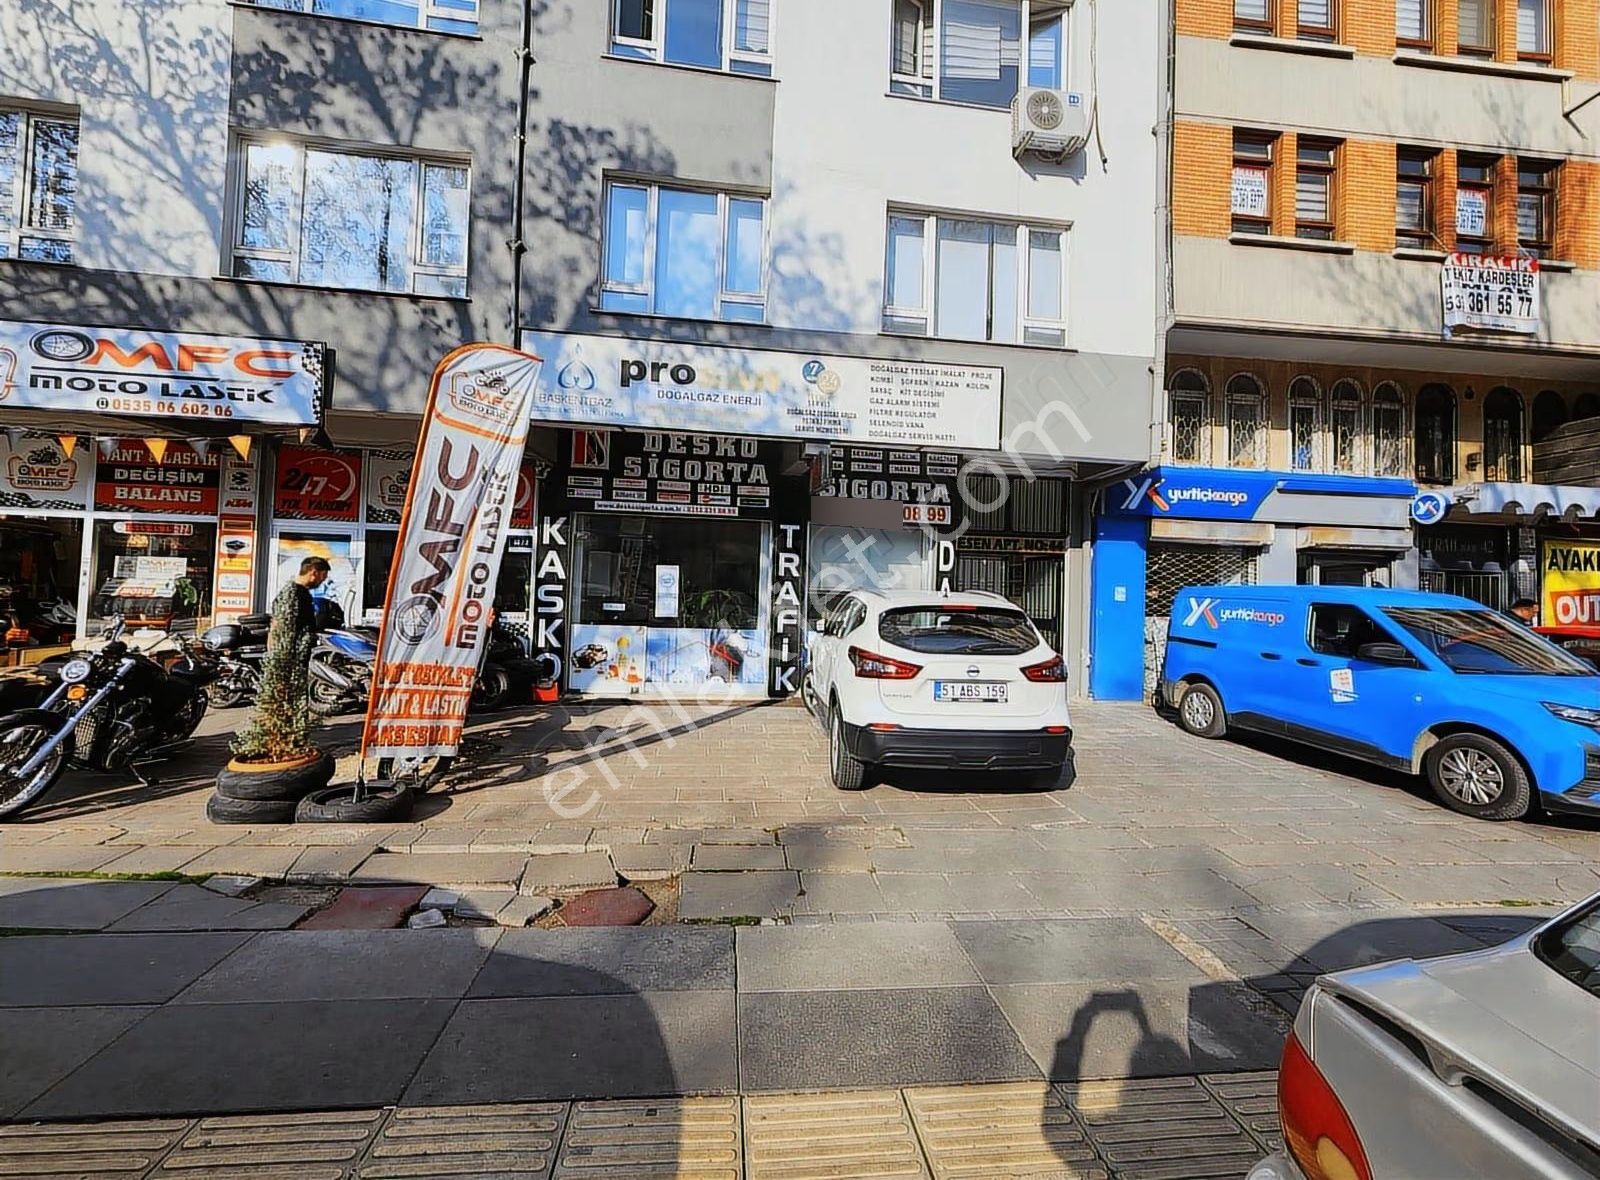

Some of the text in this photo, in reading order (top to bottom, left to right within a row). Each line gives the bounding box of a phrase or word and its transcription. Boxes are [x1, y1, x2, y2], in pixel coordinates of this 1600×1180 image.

[1468, 291, 1490, 312] 361
[1498, 294, 1512, 314] 55
[1518, 296, 1532, 317] 77
[870, 364, 908, 374] DOĞALGAZ
[971, 371, 993, 380] PROJE
[29, 374, 282, 404] MOTO LASTİK
[935, 380, 960, 388] KAZAN
[112, 399, 233, 417] 0535 06 602 06
[722, 393, 762, 407] ENERJİ
[115, 466, 204, 484] DEĞİŞİM
[624, 454, 769, 484] SİGORTA
[115, 486, 202, 502] BALANS
[819, 474, 951, 503] SİGORTA
[903, 507, 946, 522] 08 99
[1548, 548, 1600, 572] AYAK
[456, 562, 490, 649] MOTO
[535, 516, 567, 681] KASKO
[774, 524, 801, 692] TRAFİK
[942, 684, 1005, 698] 51 ABS 159
[410, 693, 420, 715] &
